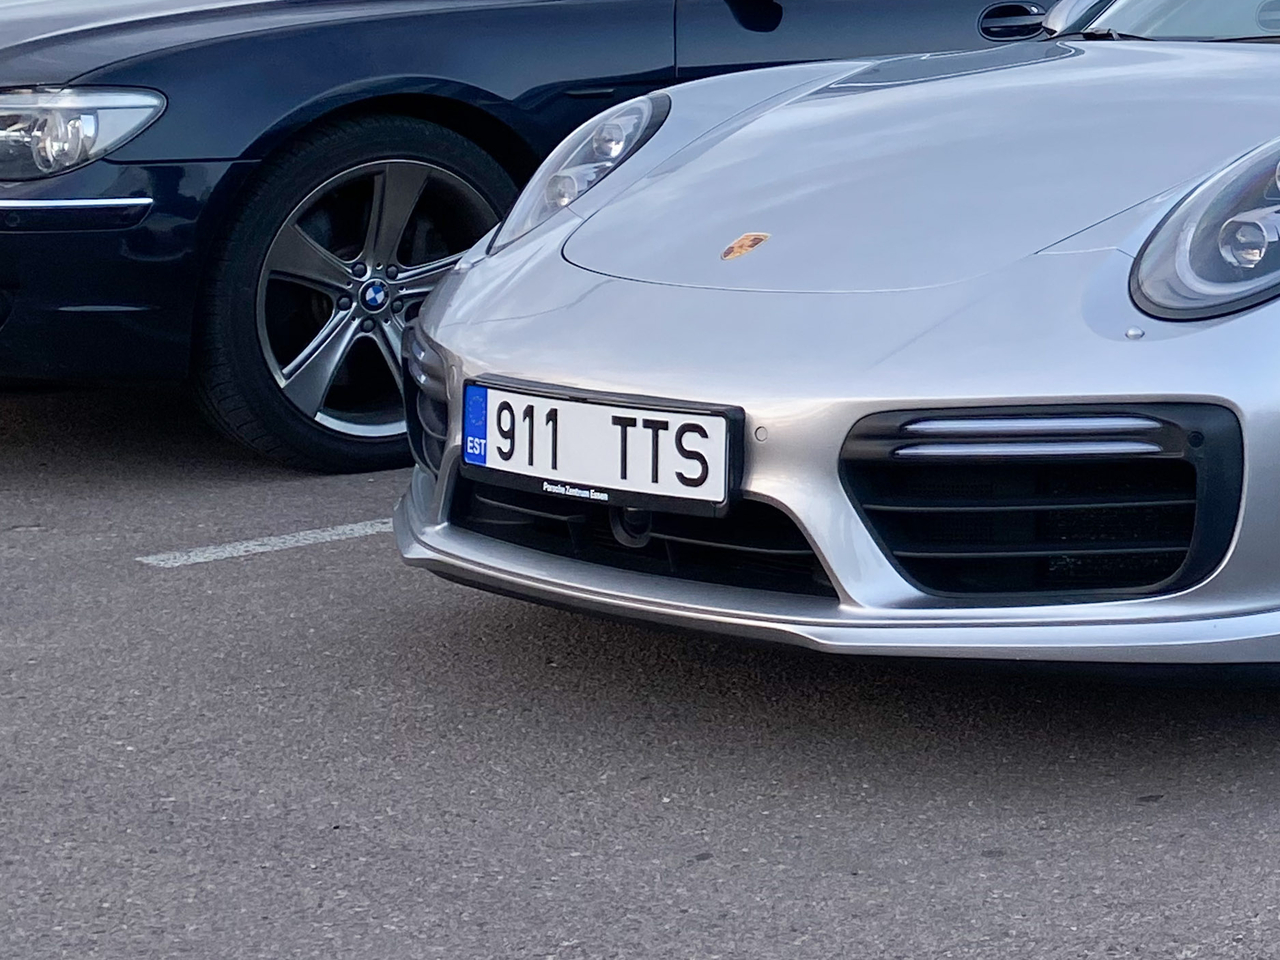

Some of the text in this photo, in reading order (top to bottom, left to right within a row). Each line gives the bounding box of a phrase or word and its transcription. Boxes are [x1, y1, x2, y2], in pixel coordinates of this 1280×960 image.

[467, 436, 487, 455] EST
[496, 400, 709, 487] 911 TTS
